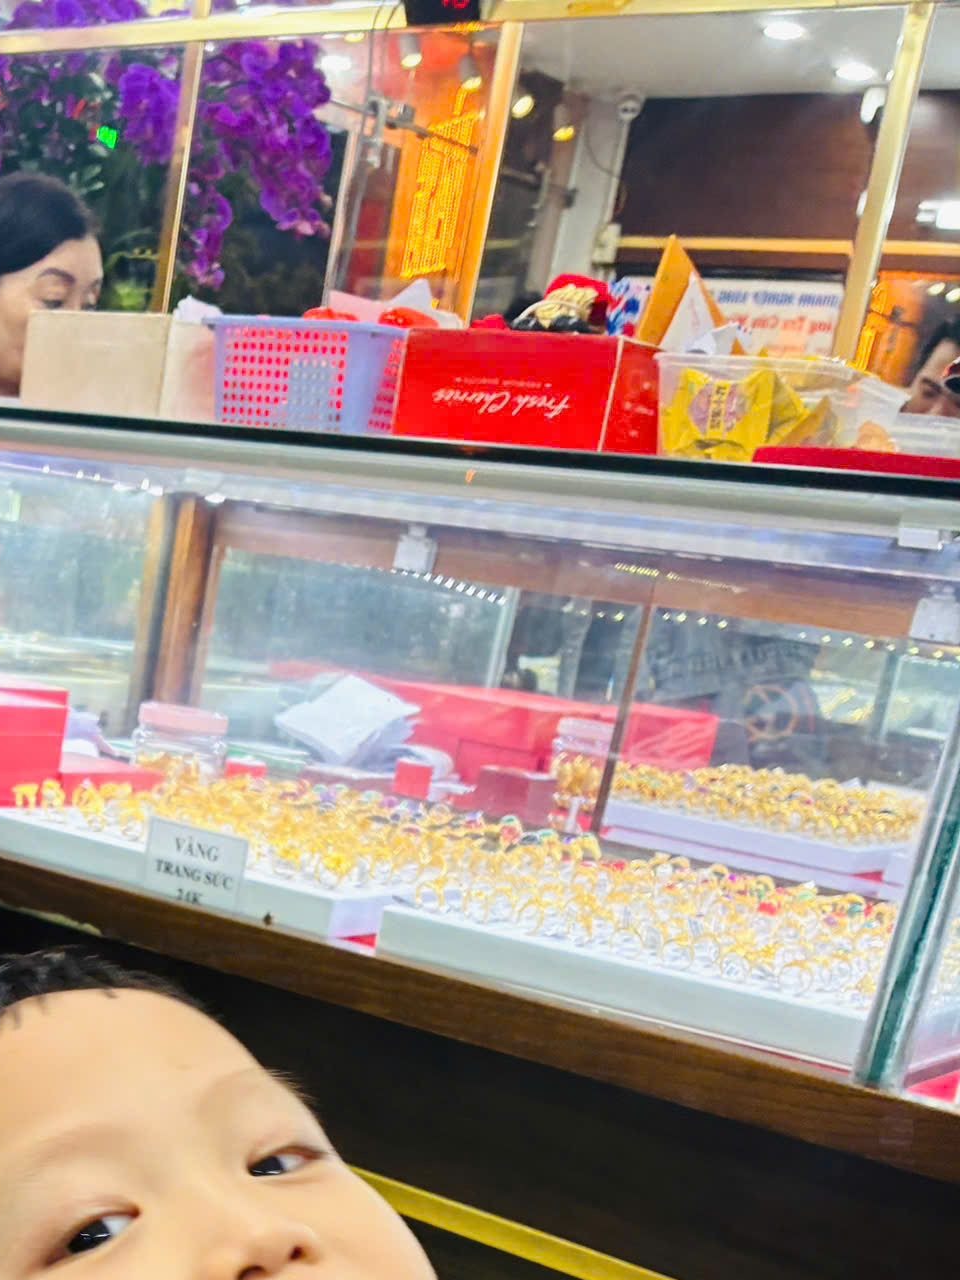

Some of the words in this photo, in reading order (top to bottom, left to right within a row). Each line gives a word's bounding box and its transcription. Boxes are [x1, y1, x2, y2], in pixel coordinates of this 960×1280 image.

[432, 388, 511, 414] Cherries
[511, 393, 571, 419] Fresh
[175, 835, 220, 862] VÀNG
[155, 859, 202, 882] TRANG
[176, 887, 203, 905] 24K
